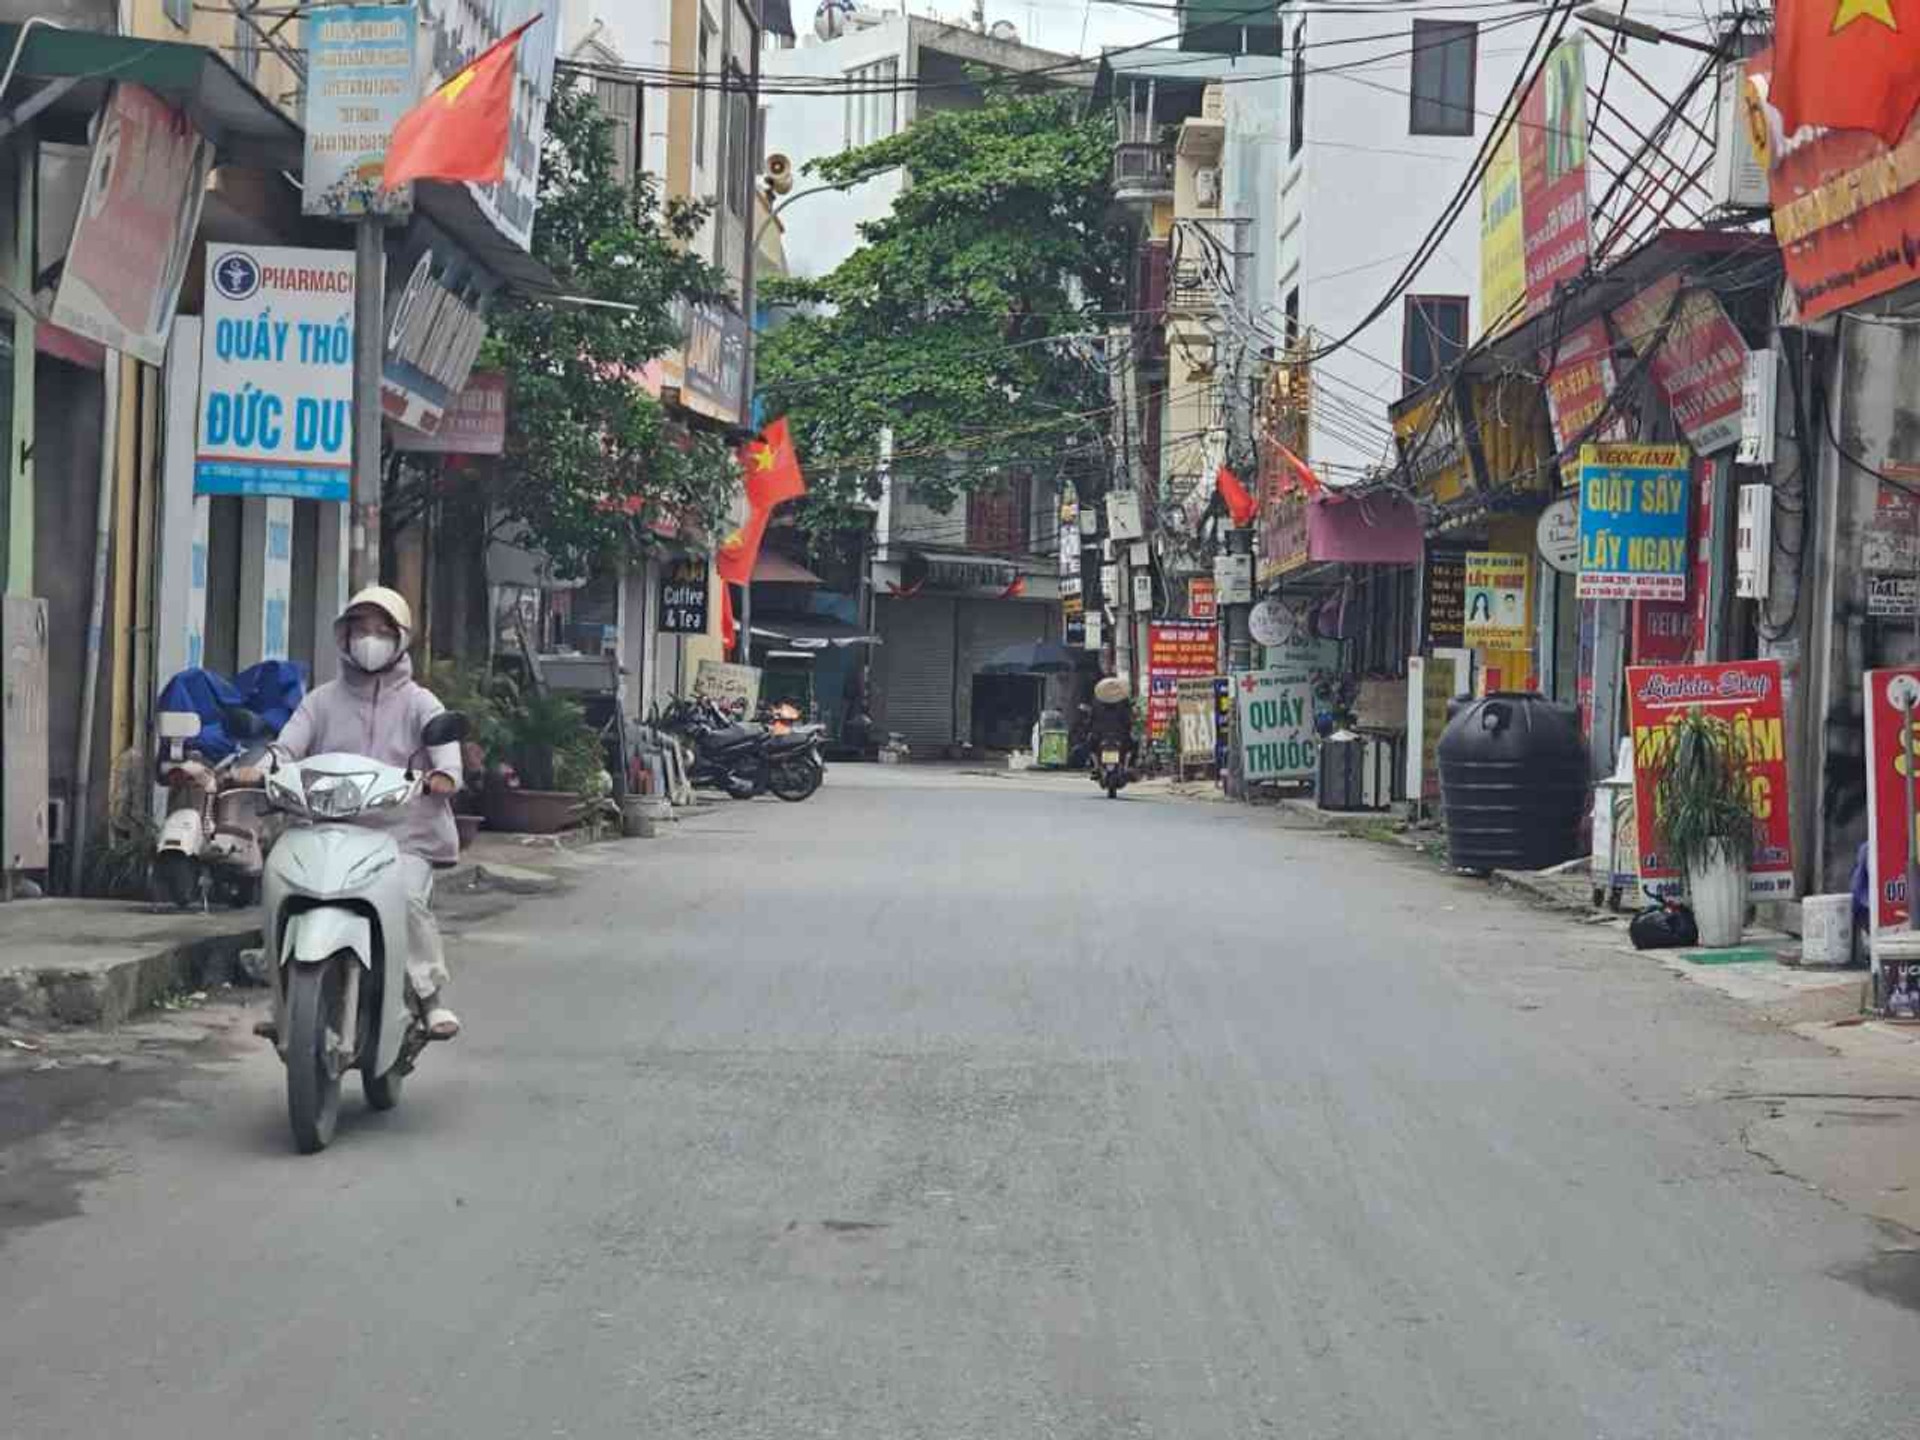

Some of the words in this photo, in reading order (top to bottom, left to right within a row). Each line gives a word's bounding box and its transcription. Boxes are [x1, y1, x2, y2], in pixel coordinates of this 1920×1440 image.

[298, 312, 355, 364] THỐ
[207, 382, 283, 450] ĐỨC
[295, 397, 353, 453] DU
[1588, 471, 1634, 519] GIẶT
[1642, 471, 1683, 514] SẤY
[1583, 528, 1621, 569] LẤY
[1628, 536, 1685, 572] NGAY
[664, 585, 704, 606] Coffee
[665, 610, 676, 628] &
[678, 609, 702, 628] Tea
[1246, 729, 1316, 773] THUỐC
